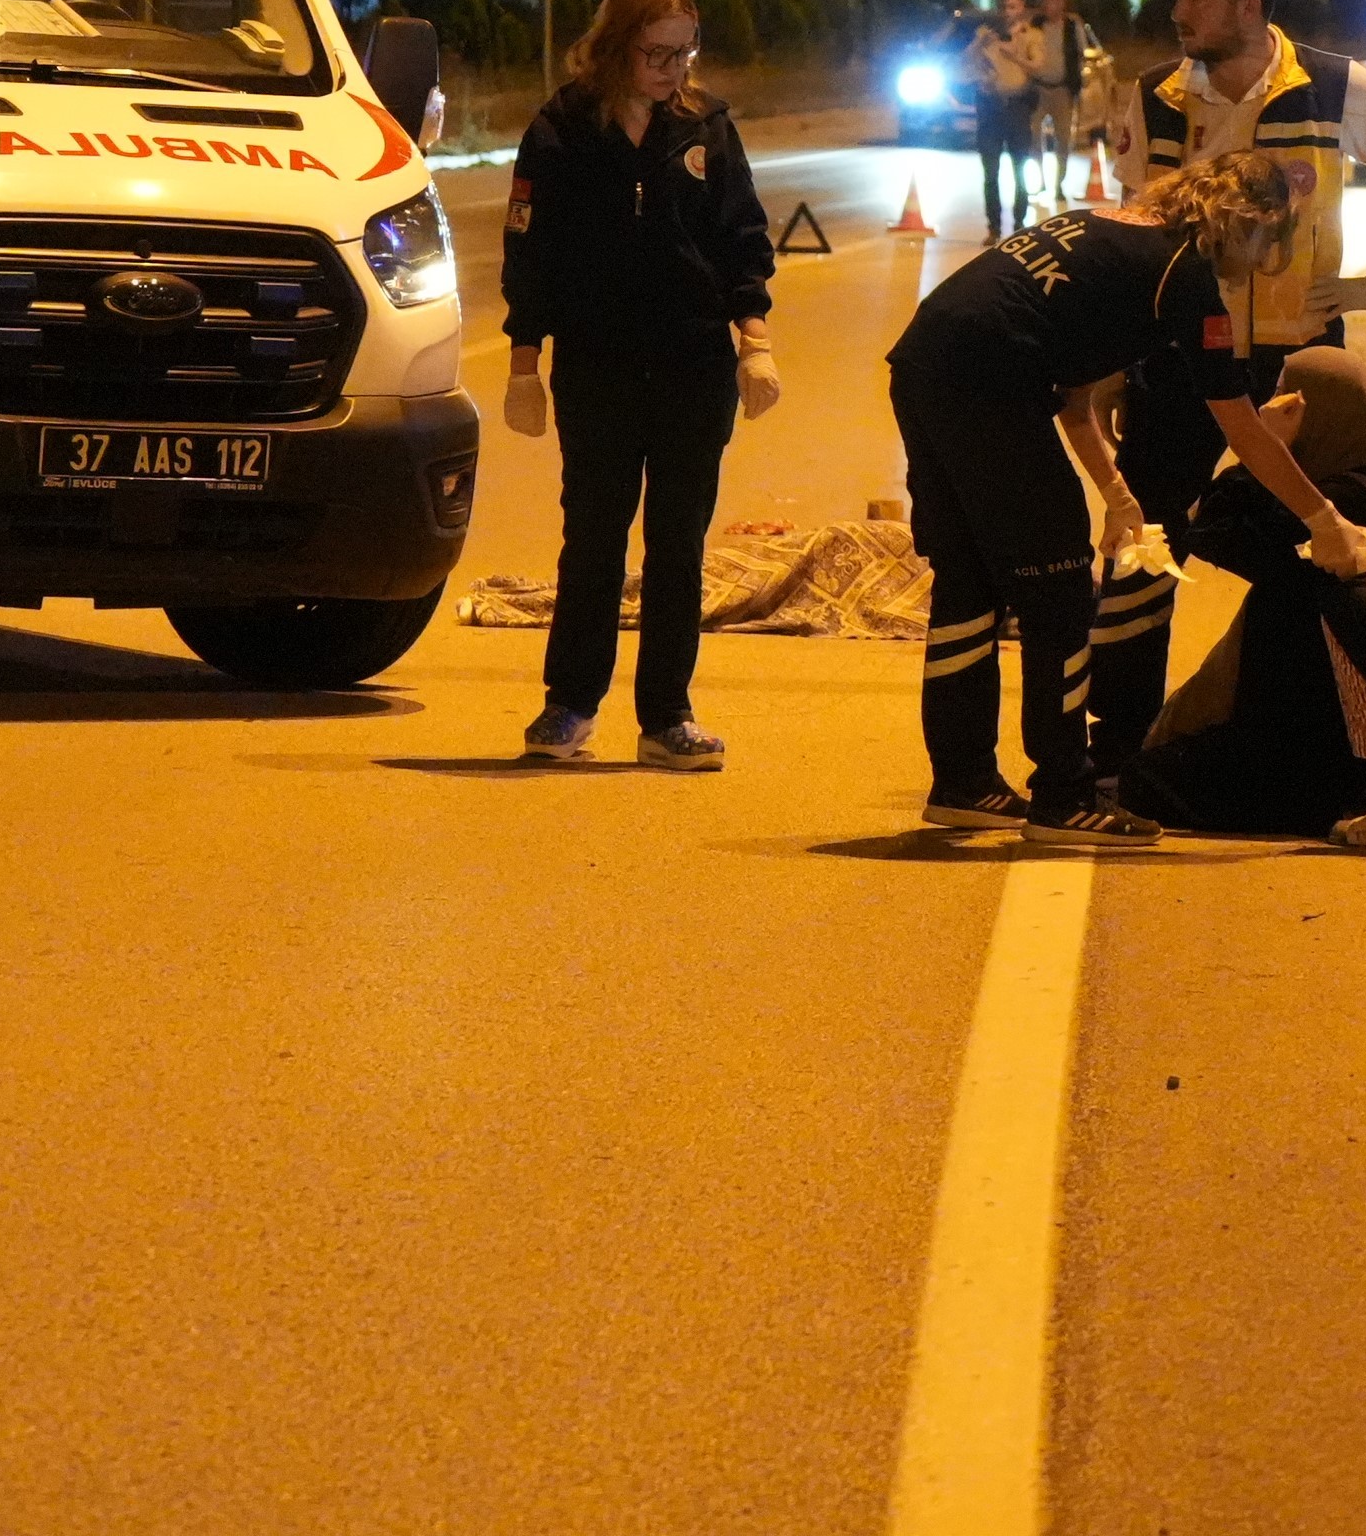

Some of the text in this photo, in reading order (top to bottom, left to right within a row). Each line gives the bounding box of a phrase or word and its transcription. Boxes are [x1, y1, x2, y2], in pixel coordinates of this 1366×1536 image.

[1039, 216, 1086, 252] CİL
[994, 230, 1071, 296] ĞLIK
[69, 433, 263, 477] 37 AAS 112
